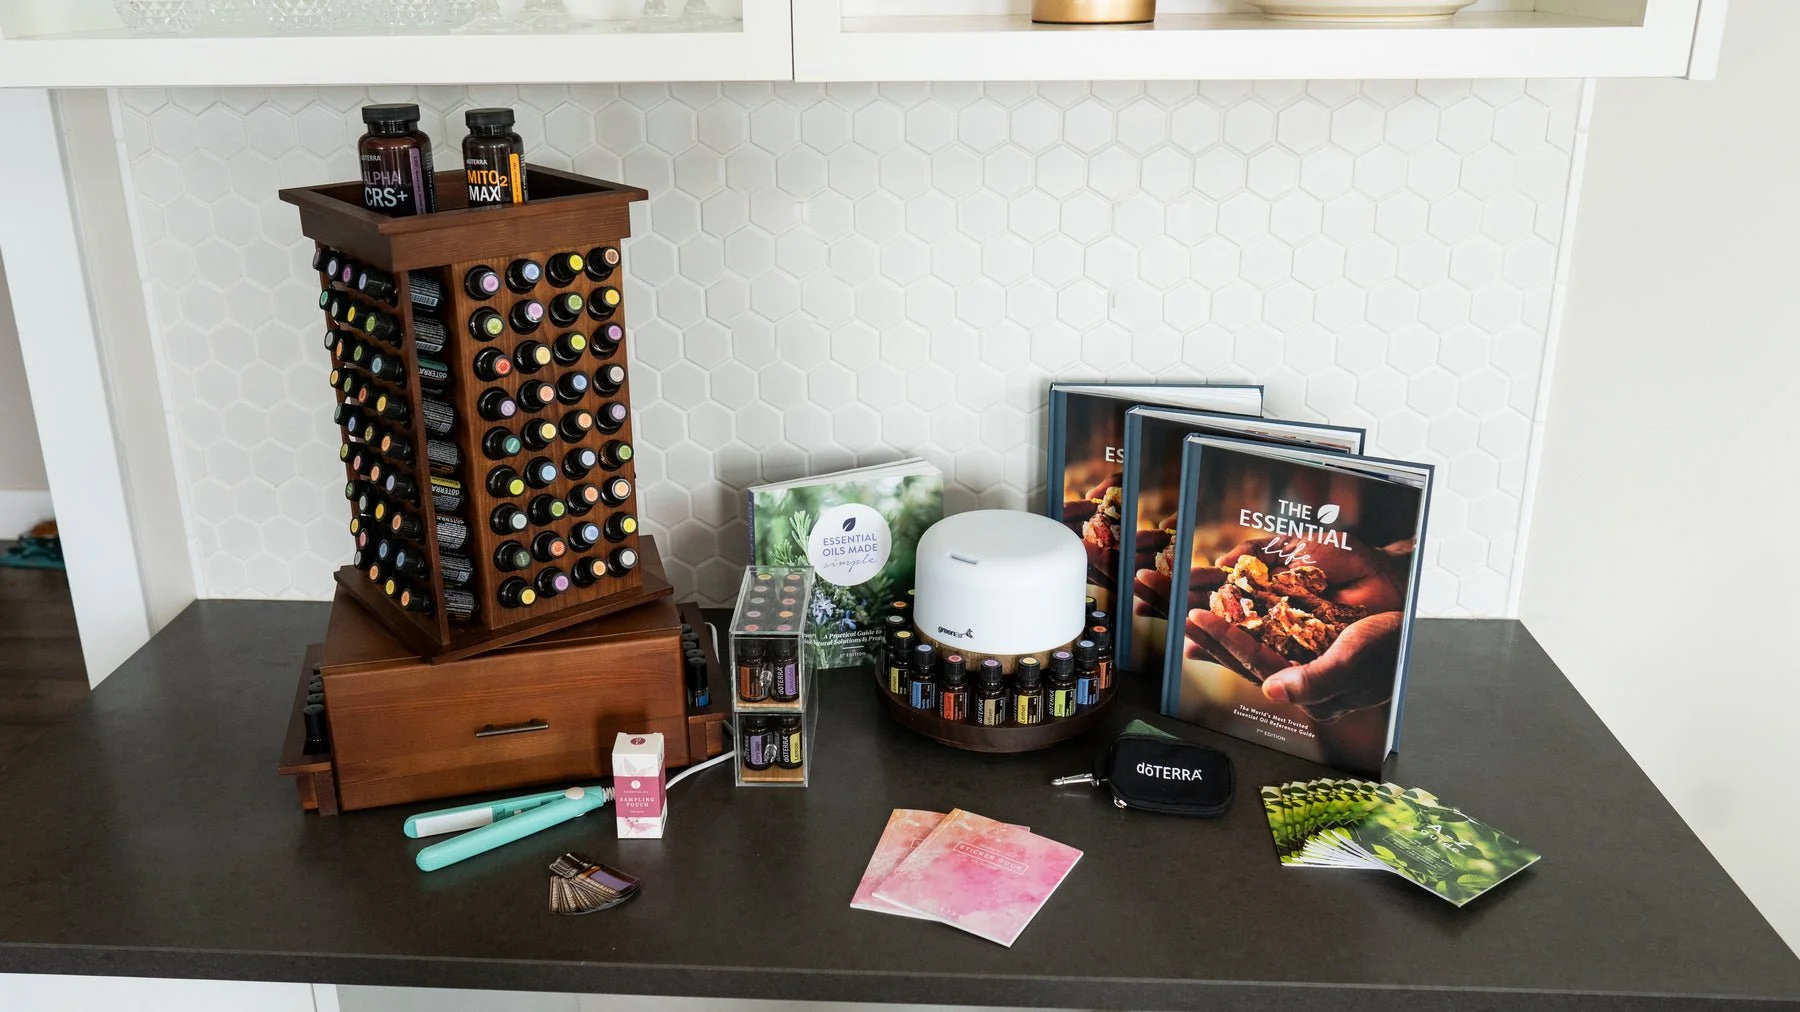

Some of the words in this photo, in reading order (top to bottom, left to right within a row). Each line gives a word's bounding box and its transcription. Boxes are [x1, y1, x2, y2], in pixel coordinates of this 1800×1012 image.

[363, 170, 401, 186] ALPHA
[364, 187, 408, 208] CRS+
[469, 185, 501, 202] MAX
[1277, 499, 1312, 521] THE
[823, 533, 878, 546] ESSENTIAL
[1239, 508, 1353, 552] ESSENTIAL
[822, 546, 846, 557] OILS
[848, 543, 878, 554] MADE
[1261, 537, 1318, 565] life
[823, 554, 878, 573] simple
[829, 631, 856, 640] Practical
[857, 629, 875, 637] Guide
[833, 637, 861, 645] Solutions
[1233, 709, 1258, 721] Essential
[1259, 716, 1268, 724] Oil
[1269, 720, 1297, 733] Reference
[1298, 729, 1316, 739] Guide
[1239, 704, 1249, 712] The
[1250, 708, 1271, 719] World's
[1272, 715, 1286, 723] Most
[1287, 718, 1309, 730] Trusted
[1264, 730, 1286, 741] EDITION
[958, 843, 996, 861] STICKER
[997, 856, 1024, 872] BOOK
